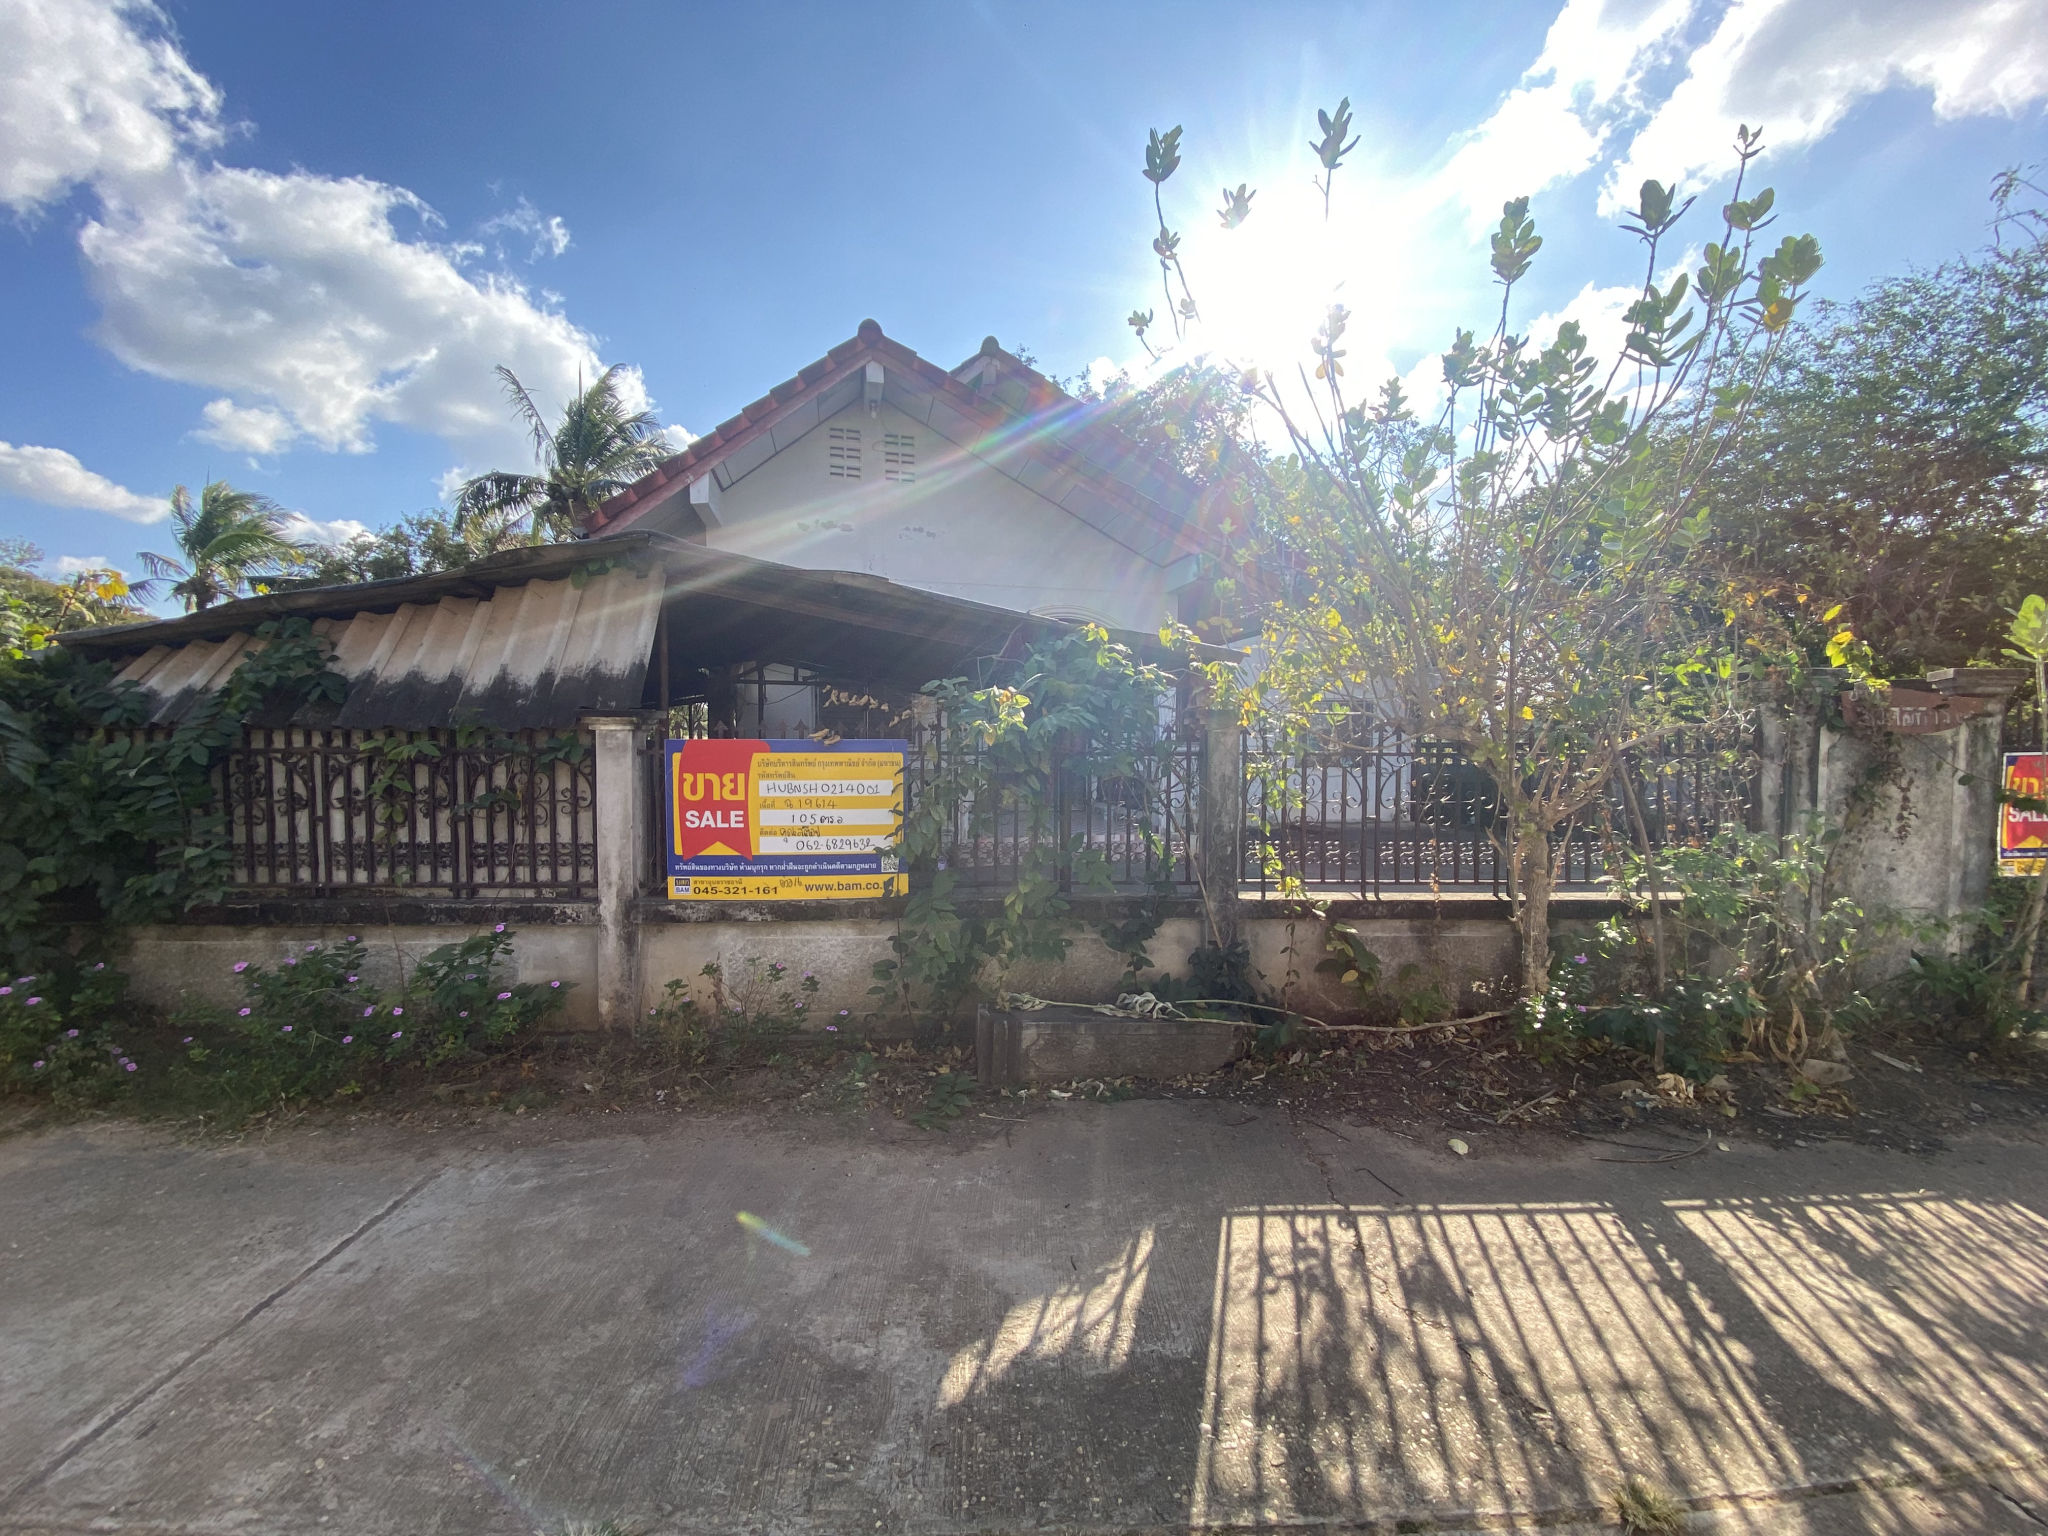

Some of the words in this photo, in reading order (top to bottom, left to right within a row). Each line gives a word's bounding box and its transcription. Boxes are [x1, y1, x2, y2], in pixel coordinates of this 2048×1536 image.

[861, 757, 877, 768] จำกัด
[682, 773, 745, 801] ขาย
[685, 810, 745, 828] SALE
[792, 813, 817, 825] 105
[739, 862, 768, 873] ห้ามบุกรุก
[693, 886, 778, 895] 045-321-161
[804, 881, 884, 892] www.bam.co.
